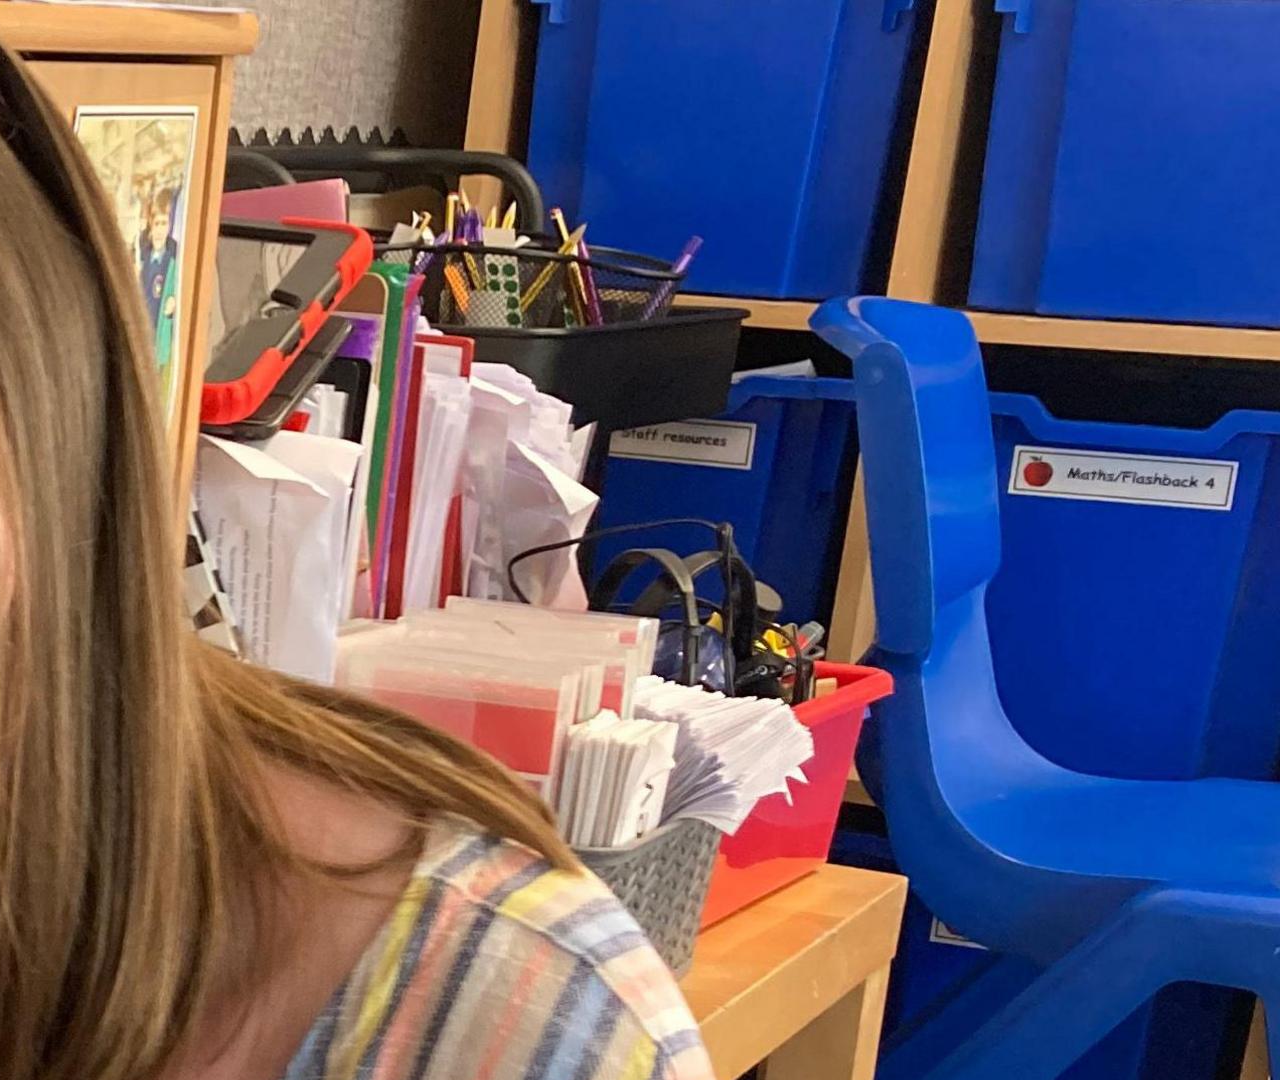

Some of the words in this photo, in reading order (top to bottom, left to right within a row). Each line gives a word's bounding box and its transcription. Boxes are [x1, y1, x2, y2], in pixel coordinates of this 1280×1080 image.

[663, 432, 727, 447] resources
[1067, 467, 1199, 489] Maths/Flashback
[1205, 477, 1216, 490] 4
